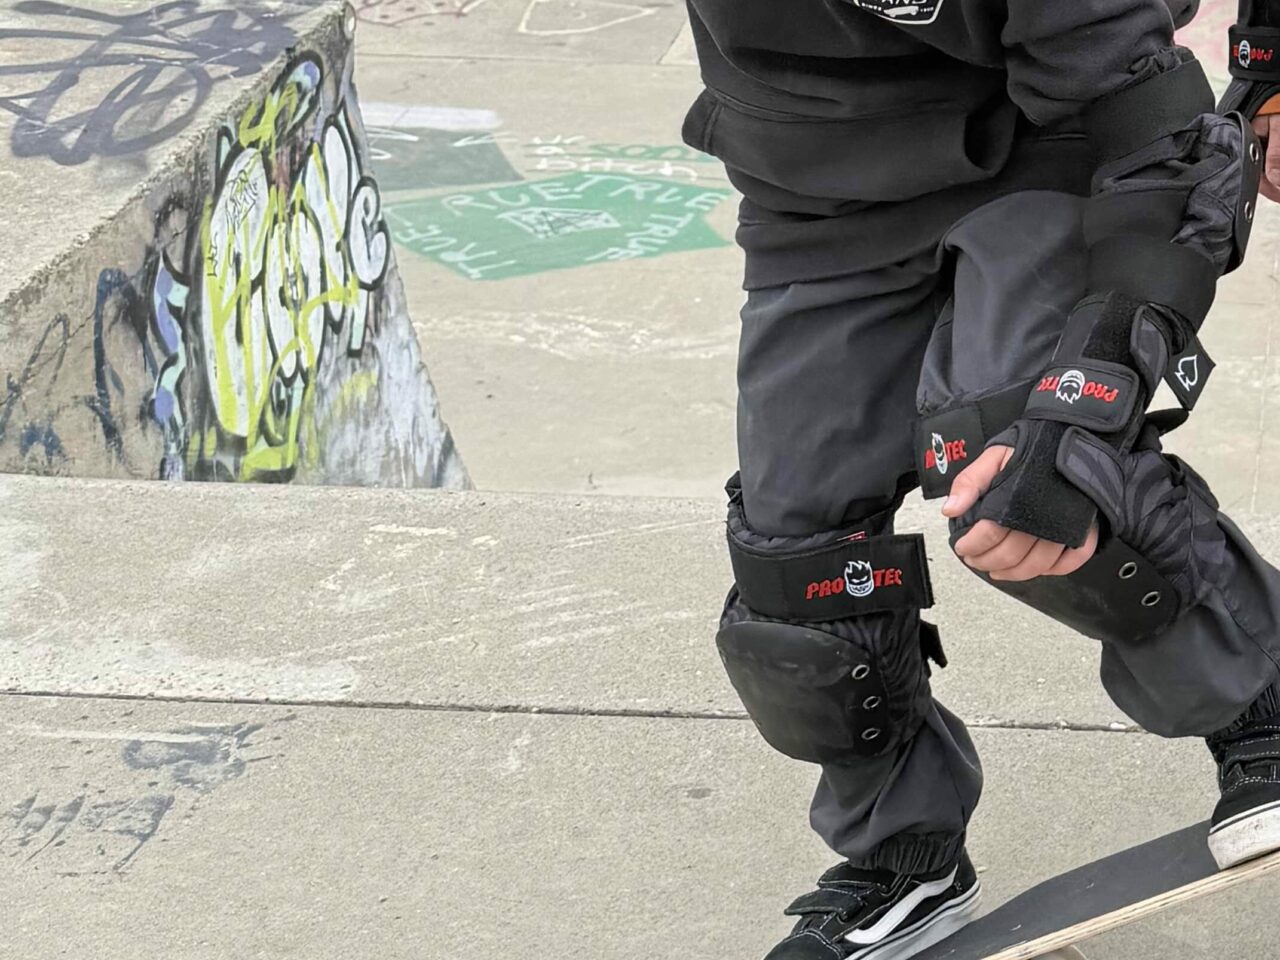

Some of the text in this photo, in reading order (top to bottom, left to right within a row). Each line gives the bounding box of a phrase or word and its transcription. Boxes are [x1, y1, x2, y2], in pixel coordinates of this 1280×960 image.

[1083, 381, 1119, 402] PRO
[945, 439, 968, 462] TEC
[805, 568, 903, 600] PRO TEC
